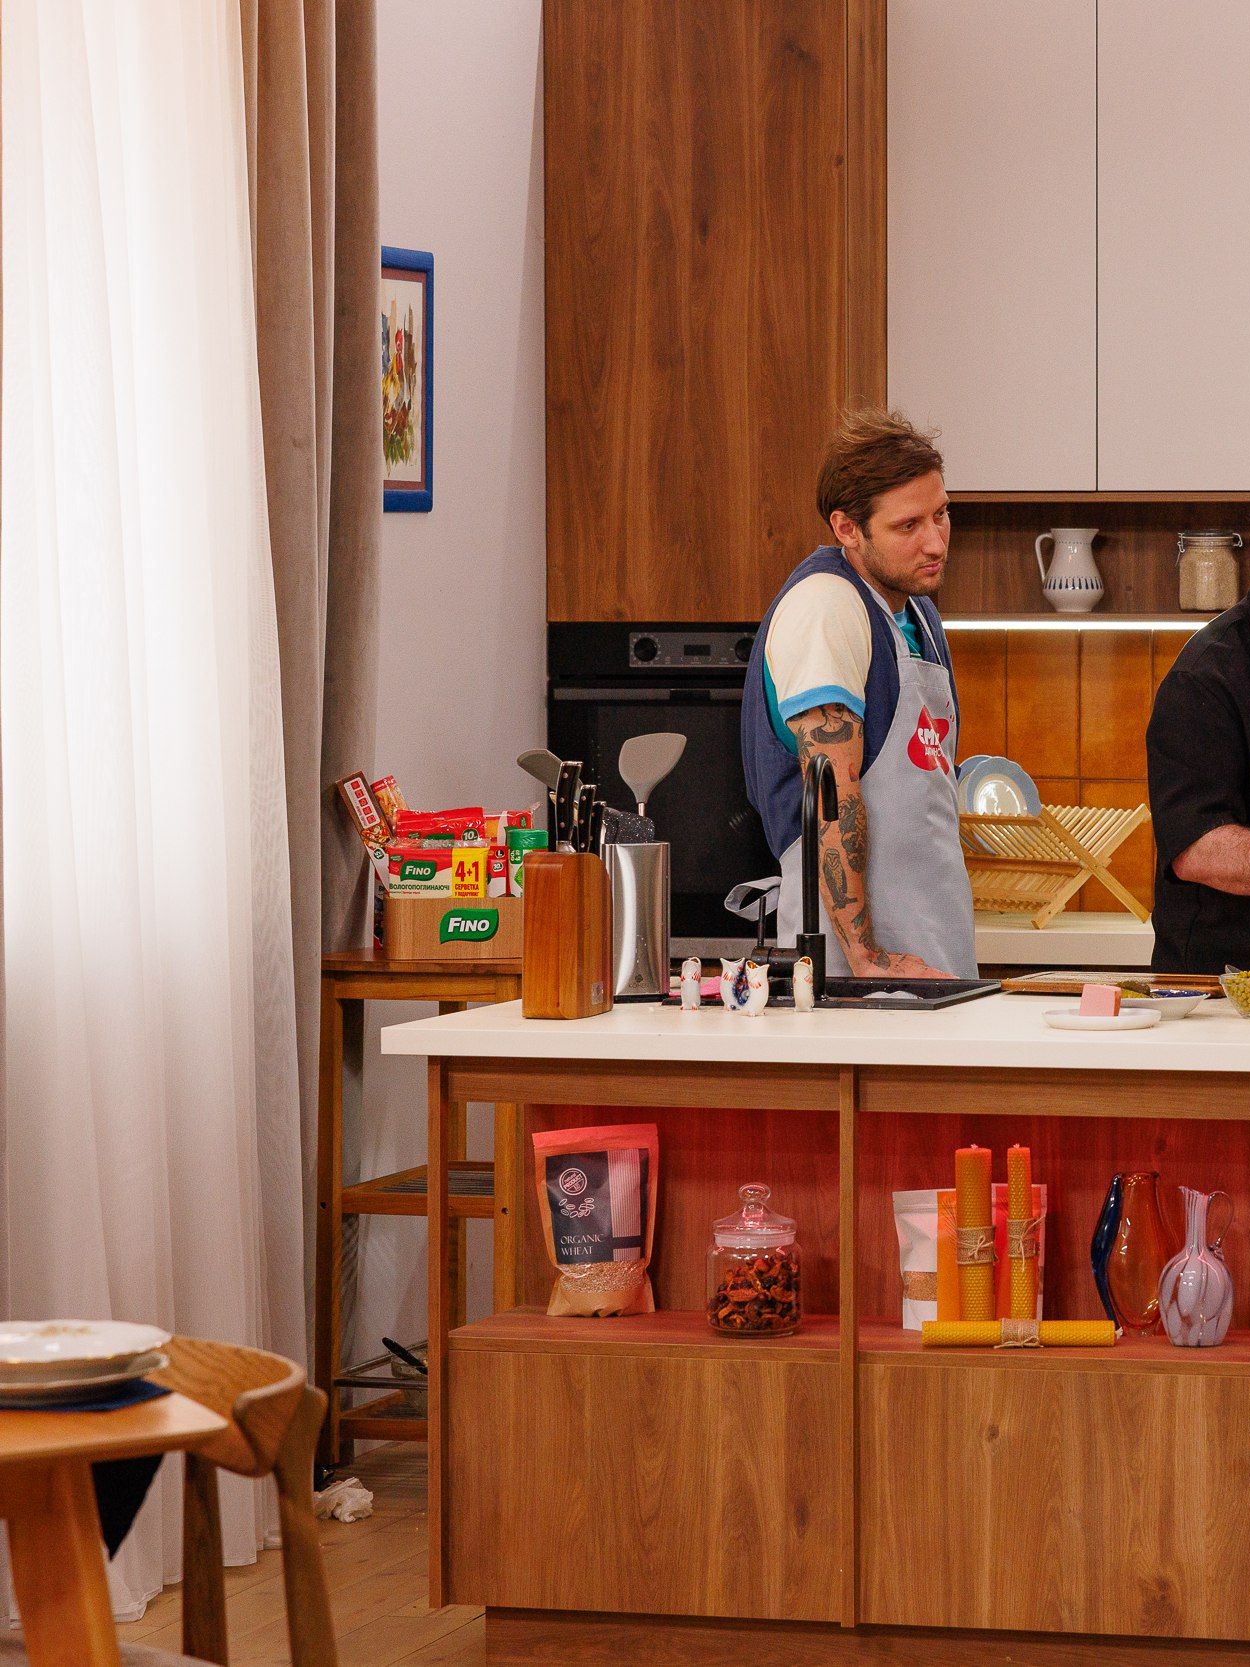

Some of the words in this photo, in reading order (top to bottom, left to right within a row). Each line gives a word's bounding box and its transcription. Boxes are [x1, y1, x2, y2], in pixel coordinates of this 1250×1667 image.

[918, 728, 940, 746] СМ
[405, 865, 431, 875] FINO
[455, 861, 480, 882] 4+1
[448, 918, 490, 932] FINO
[560, 1234, 604, 1245] ORGANIC
[561, 1246, 594, 1256] WHEAT
